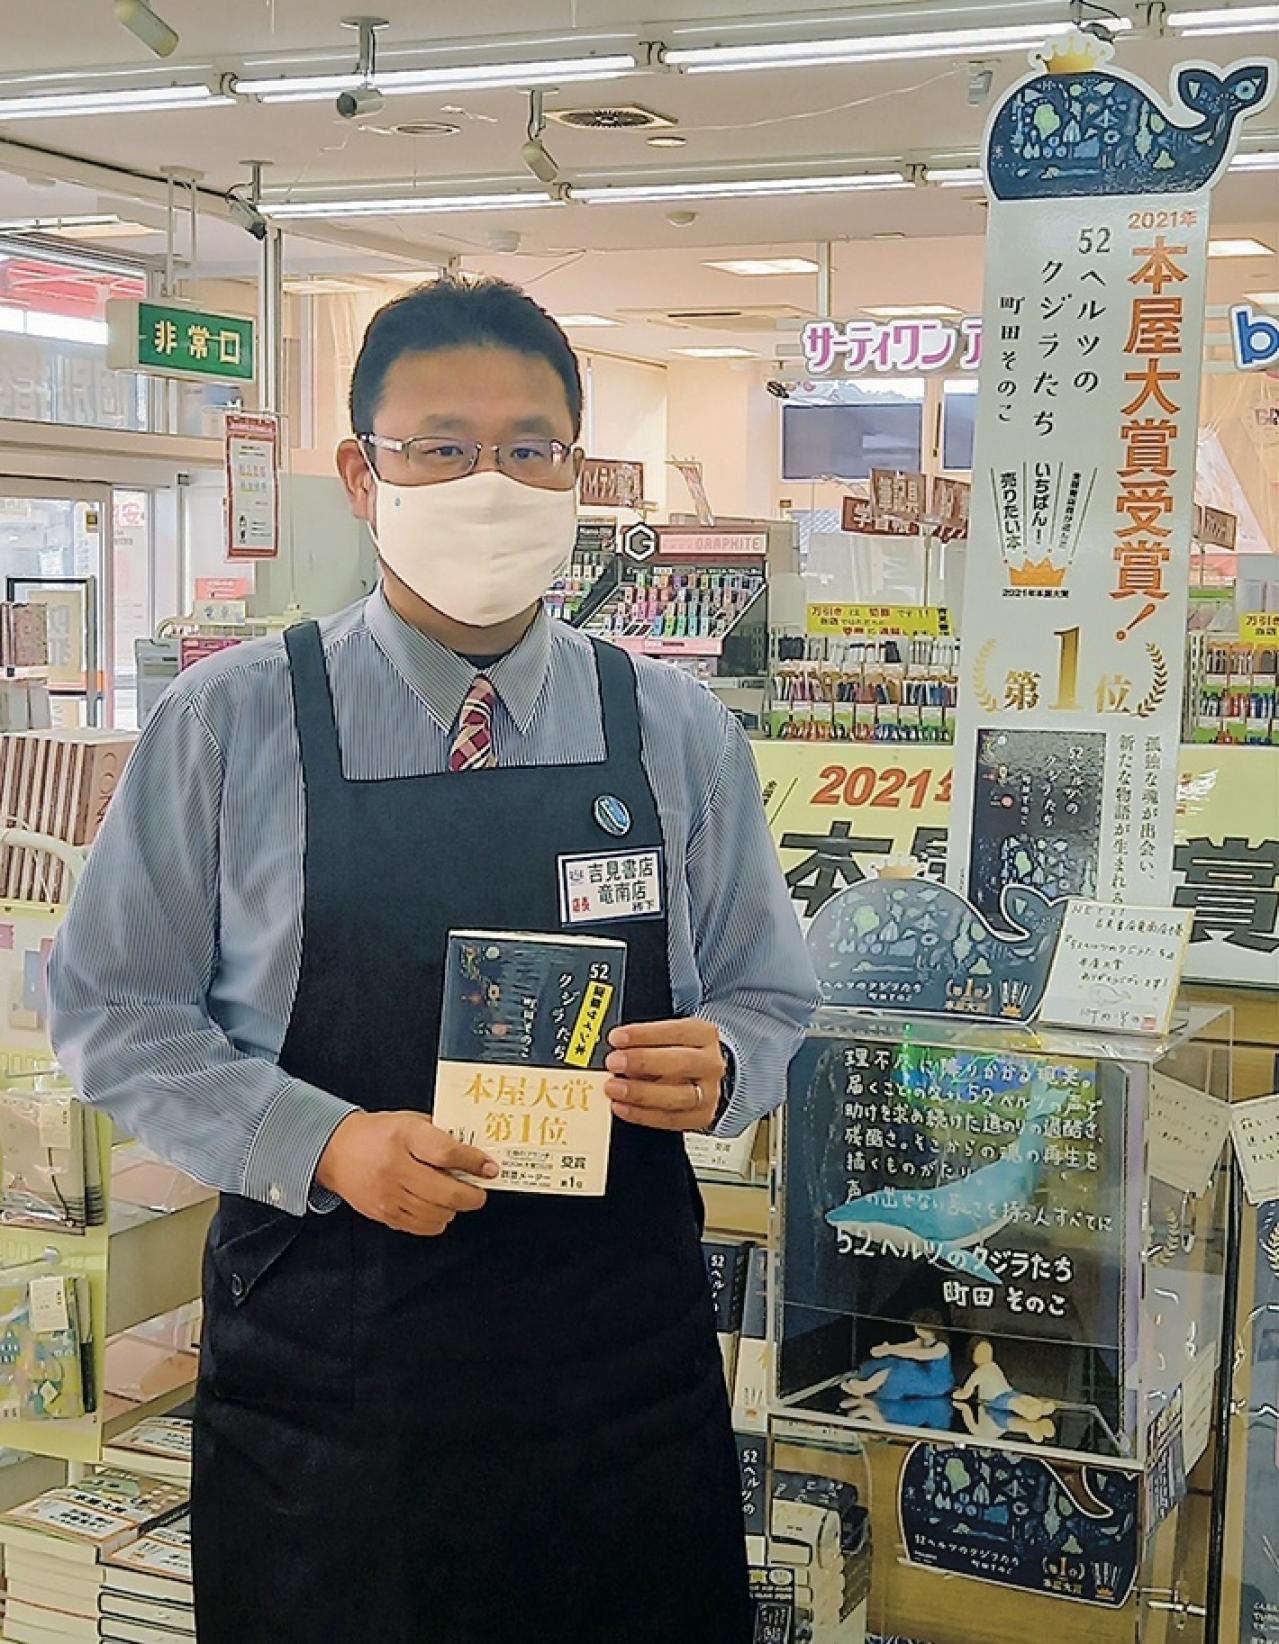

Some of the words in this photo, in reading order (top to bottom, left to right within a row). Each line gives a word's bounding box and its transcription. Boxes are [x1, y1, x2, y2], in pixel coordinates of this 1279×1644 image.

[1128, 210, 1197, 230] 2021年
[1073, 227, 1111, 393] 52ヘルツの
[154, 319, 241, 364] 非常口
[807, 324, 952, 367] サーティワン
[997, 296, 1025, 422] 町田そのこ
[1033, 260, 1073, 437] クジラたち
[1109, 235, 1189, 640] 本屋大賞受賞！
[1000, 471, 1022, 550] 売りたい本
[1004, 626, 1132, 714] 第1位
[587, 856, 653, 883] 吉見書店
[598, 880, 646, 904] 竜南店
[590, 963, 610, 980] 52
[552, 974, 580, 1060] クジラたち
[464, 1072, 595, 1112] 本屋大賞
[485, 1111, 568, 1147] 第1位
[836, 1227, 1074, 1284] 52ヘルツのクジラたち
[943, 1281, 994, 1307] 町田
[1006, 1287, 1066, 1316] そのこ
